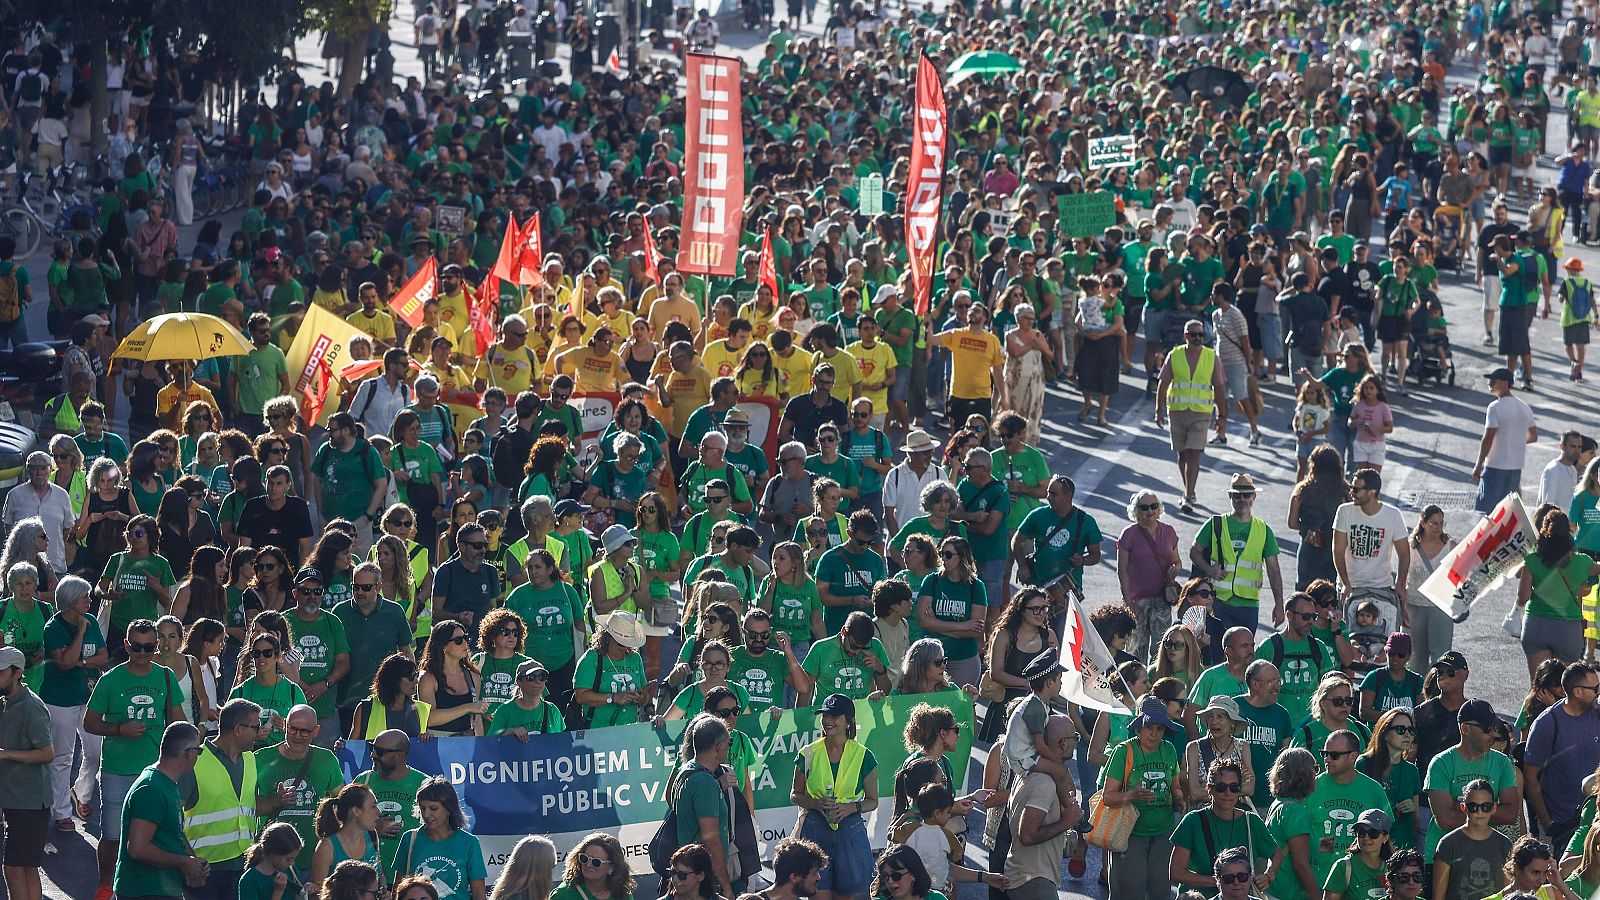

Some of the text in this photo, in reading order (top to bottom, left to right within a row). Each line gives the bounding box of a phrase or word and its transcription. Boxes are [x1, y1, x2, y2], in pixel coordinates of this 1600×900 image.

[694, 64, 729, 234] CCOO
[935, 599, 943, 613] LA
[1252, 726, 1277, 743] LLENGUA
[451, 750, 629, 785] DIGNIFIQUEM
[376, 791, 413, 802] STIMEM
[541, 784, 632, 817] PÚBLIC
